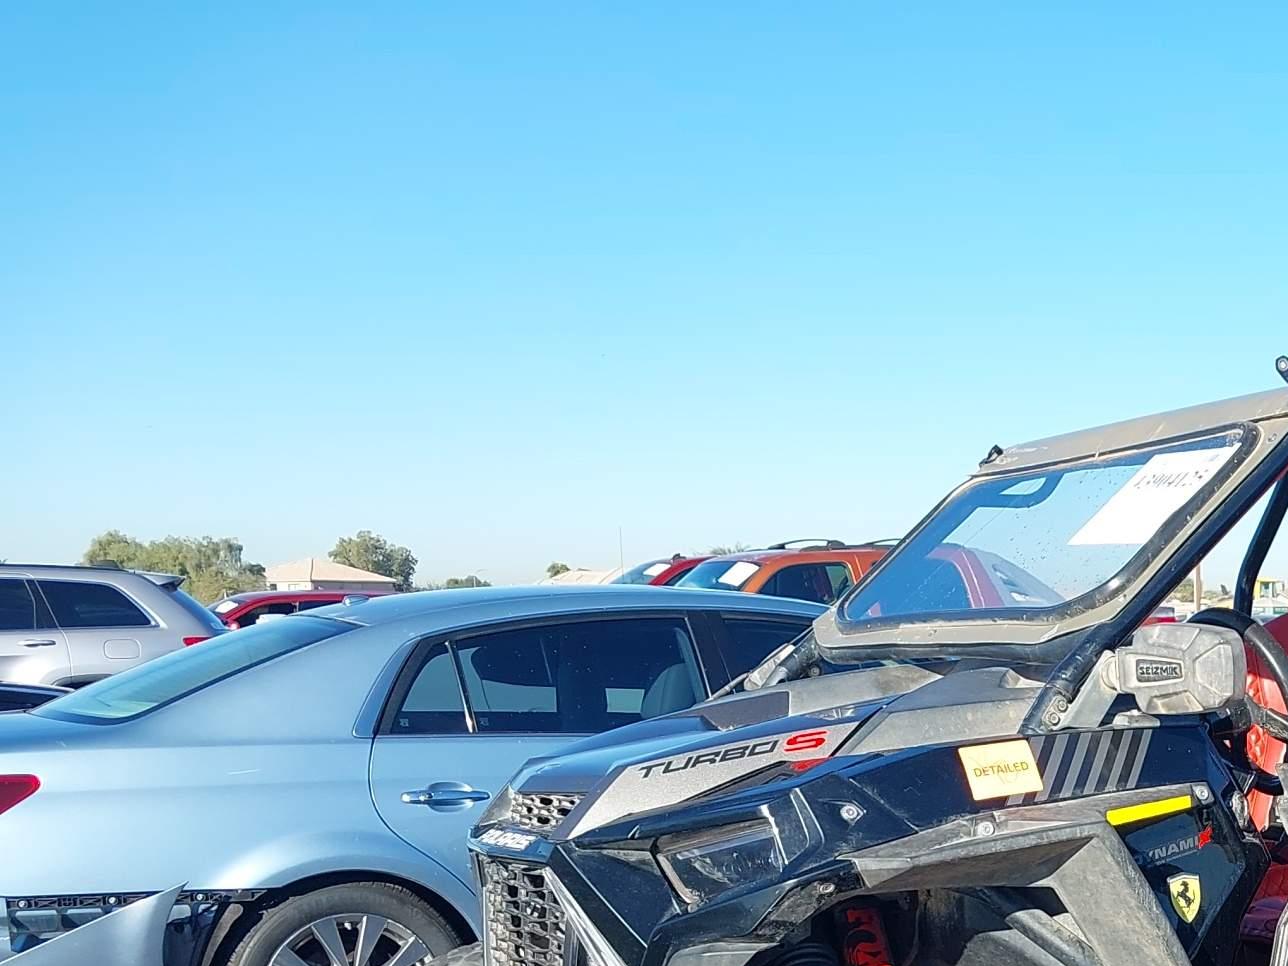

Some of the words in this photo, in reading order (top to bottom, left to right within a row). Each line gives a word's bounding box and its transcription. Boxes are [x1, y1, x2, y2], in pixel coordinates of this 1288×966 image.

[1139, 665, 1179, 676] SEIZMIK
[638, 739, 780, 779] TURBO
[783, 730, 830, 753] S
[973, 761, 1029, 778] DETAILED
